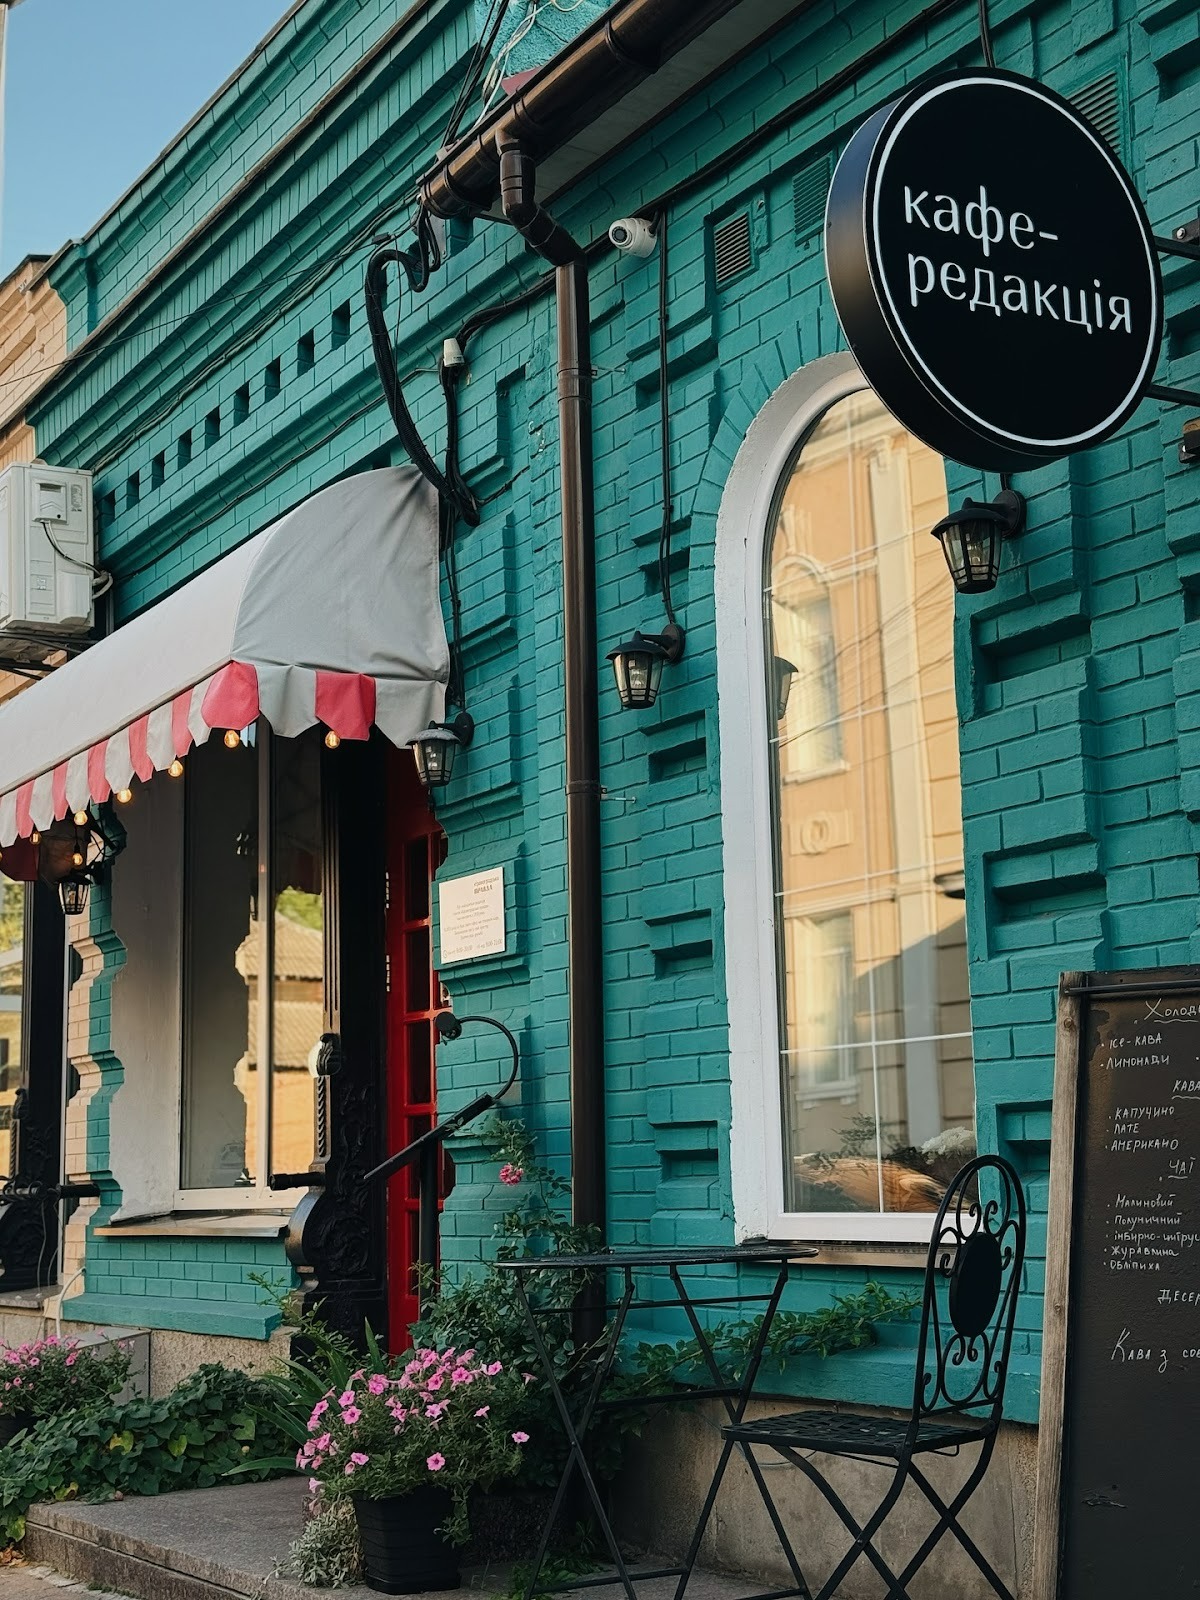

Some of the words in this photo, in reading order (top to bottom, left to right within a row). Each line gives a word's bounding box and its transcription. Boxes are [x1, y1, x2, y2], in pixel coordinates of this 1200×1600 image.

[904, 185, 1059, 257] кафе-
[908, 253, 1132, 334] редакція
[1144, 998, 1200, 1020] Холод
[1106, 1054, 1170, 1070] ЛИМОНАДИ
[1114, 1106, 1175, 1120] КАПУЧИНО
[1113, 1122, 1140, 1135] ЛАТЕ
[1110, 1138, 1179, 1153] АМЕРИКАНО
[1115, 1193, 1176, 1208] Малиновий
[1114, 1212, 1183, 1231] Полуничний
